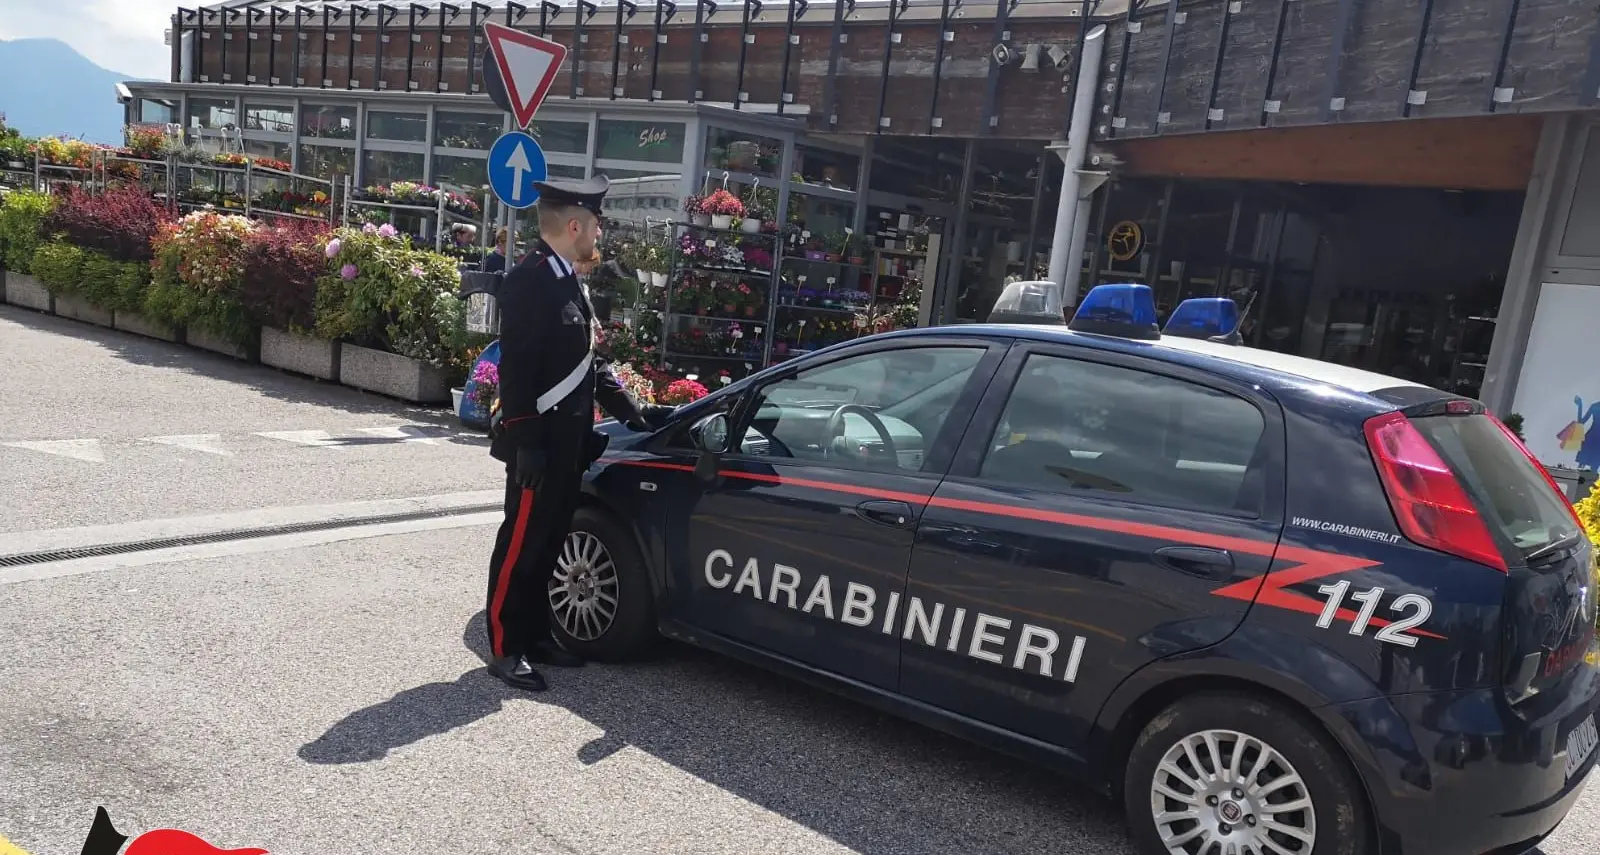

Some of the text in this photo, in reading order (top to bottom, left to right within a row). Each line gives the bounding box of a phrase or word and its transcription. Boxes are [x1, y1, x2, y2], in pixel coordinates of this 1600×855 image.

[638, 126, 668, 148] Shop
[1292, 516, 1401, 544] WWW.CARABINIERI.IT
[704, 548, 1087, 684] CARABINIERI
[1315, 579, 1432, 648] 112
